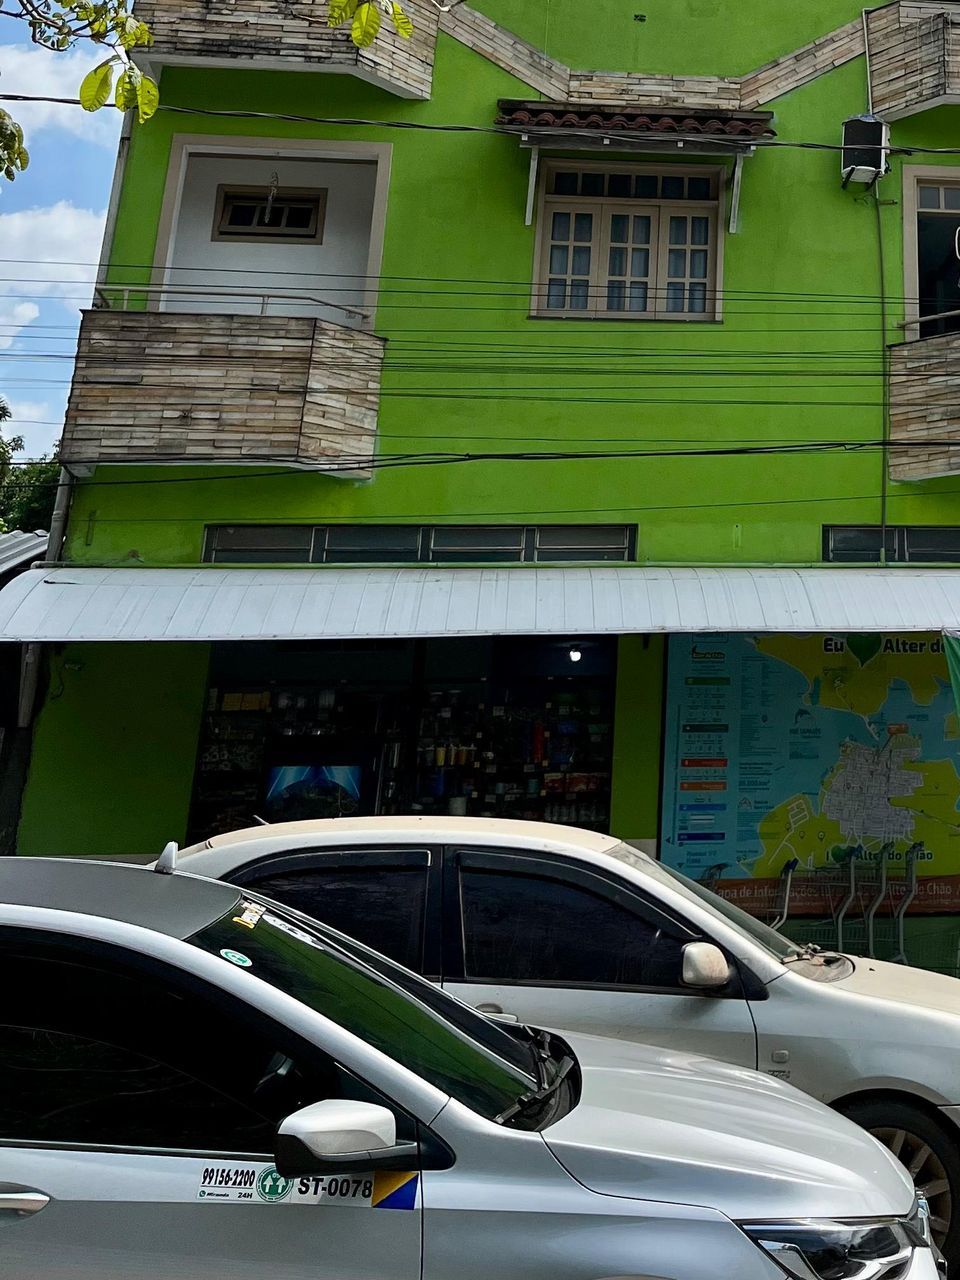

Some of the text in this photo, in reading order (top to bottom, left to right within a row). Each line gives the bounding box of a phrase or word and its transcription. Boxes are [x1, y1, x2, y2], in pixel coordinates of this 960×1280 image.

[823, 637, 845, 652] Eu
[882, 637, 927, 654] Alter
[856, 850, 880, 861] Alte
[754, 885, 816, 899] inforações
[926, 881, 953, 895] Chão
[202, 1167, 257, 1187] 99156-2200
[297, 1176, 374, 1199] ST-0078
[237, 1191, 254, 1200] 24H
